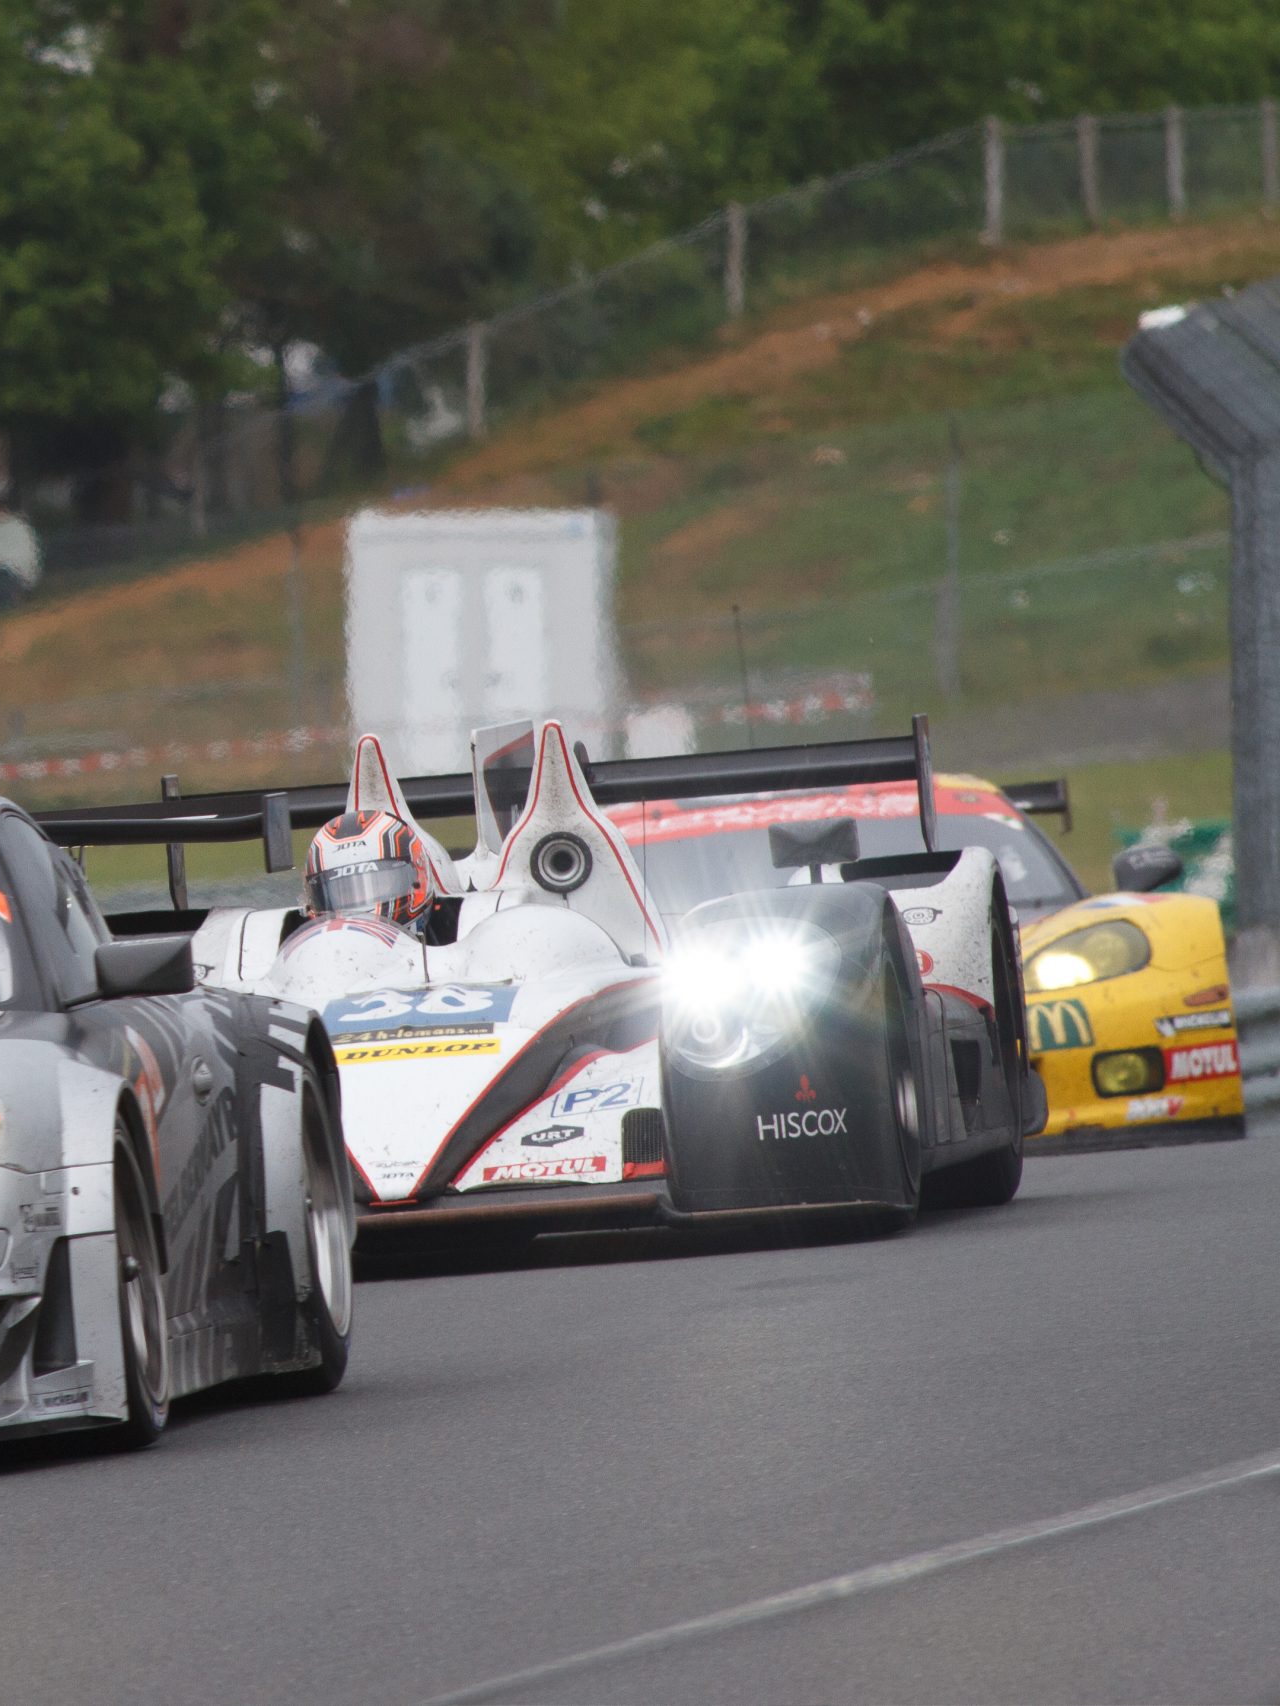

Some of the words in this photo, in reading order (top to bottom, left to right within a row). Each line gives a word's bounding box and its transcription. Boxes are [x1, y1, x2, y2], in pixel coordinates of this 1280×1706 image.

[328, 861, 379, 880] JOTA
[343, 1042, 496, 1060] DUNLOP
[1170, 1044, 1237, 1079] MOTUL
[562, 1082, 632, 1112] P2
[757, 1108, 847, 1140] HISCOX
[491, 1157, 597, 1180] MOTUL
